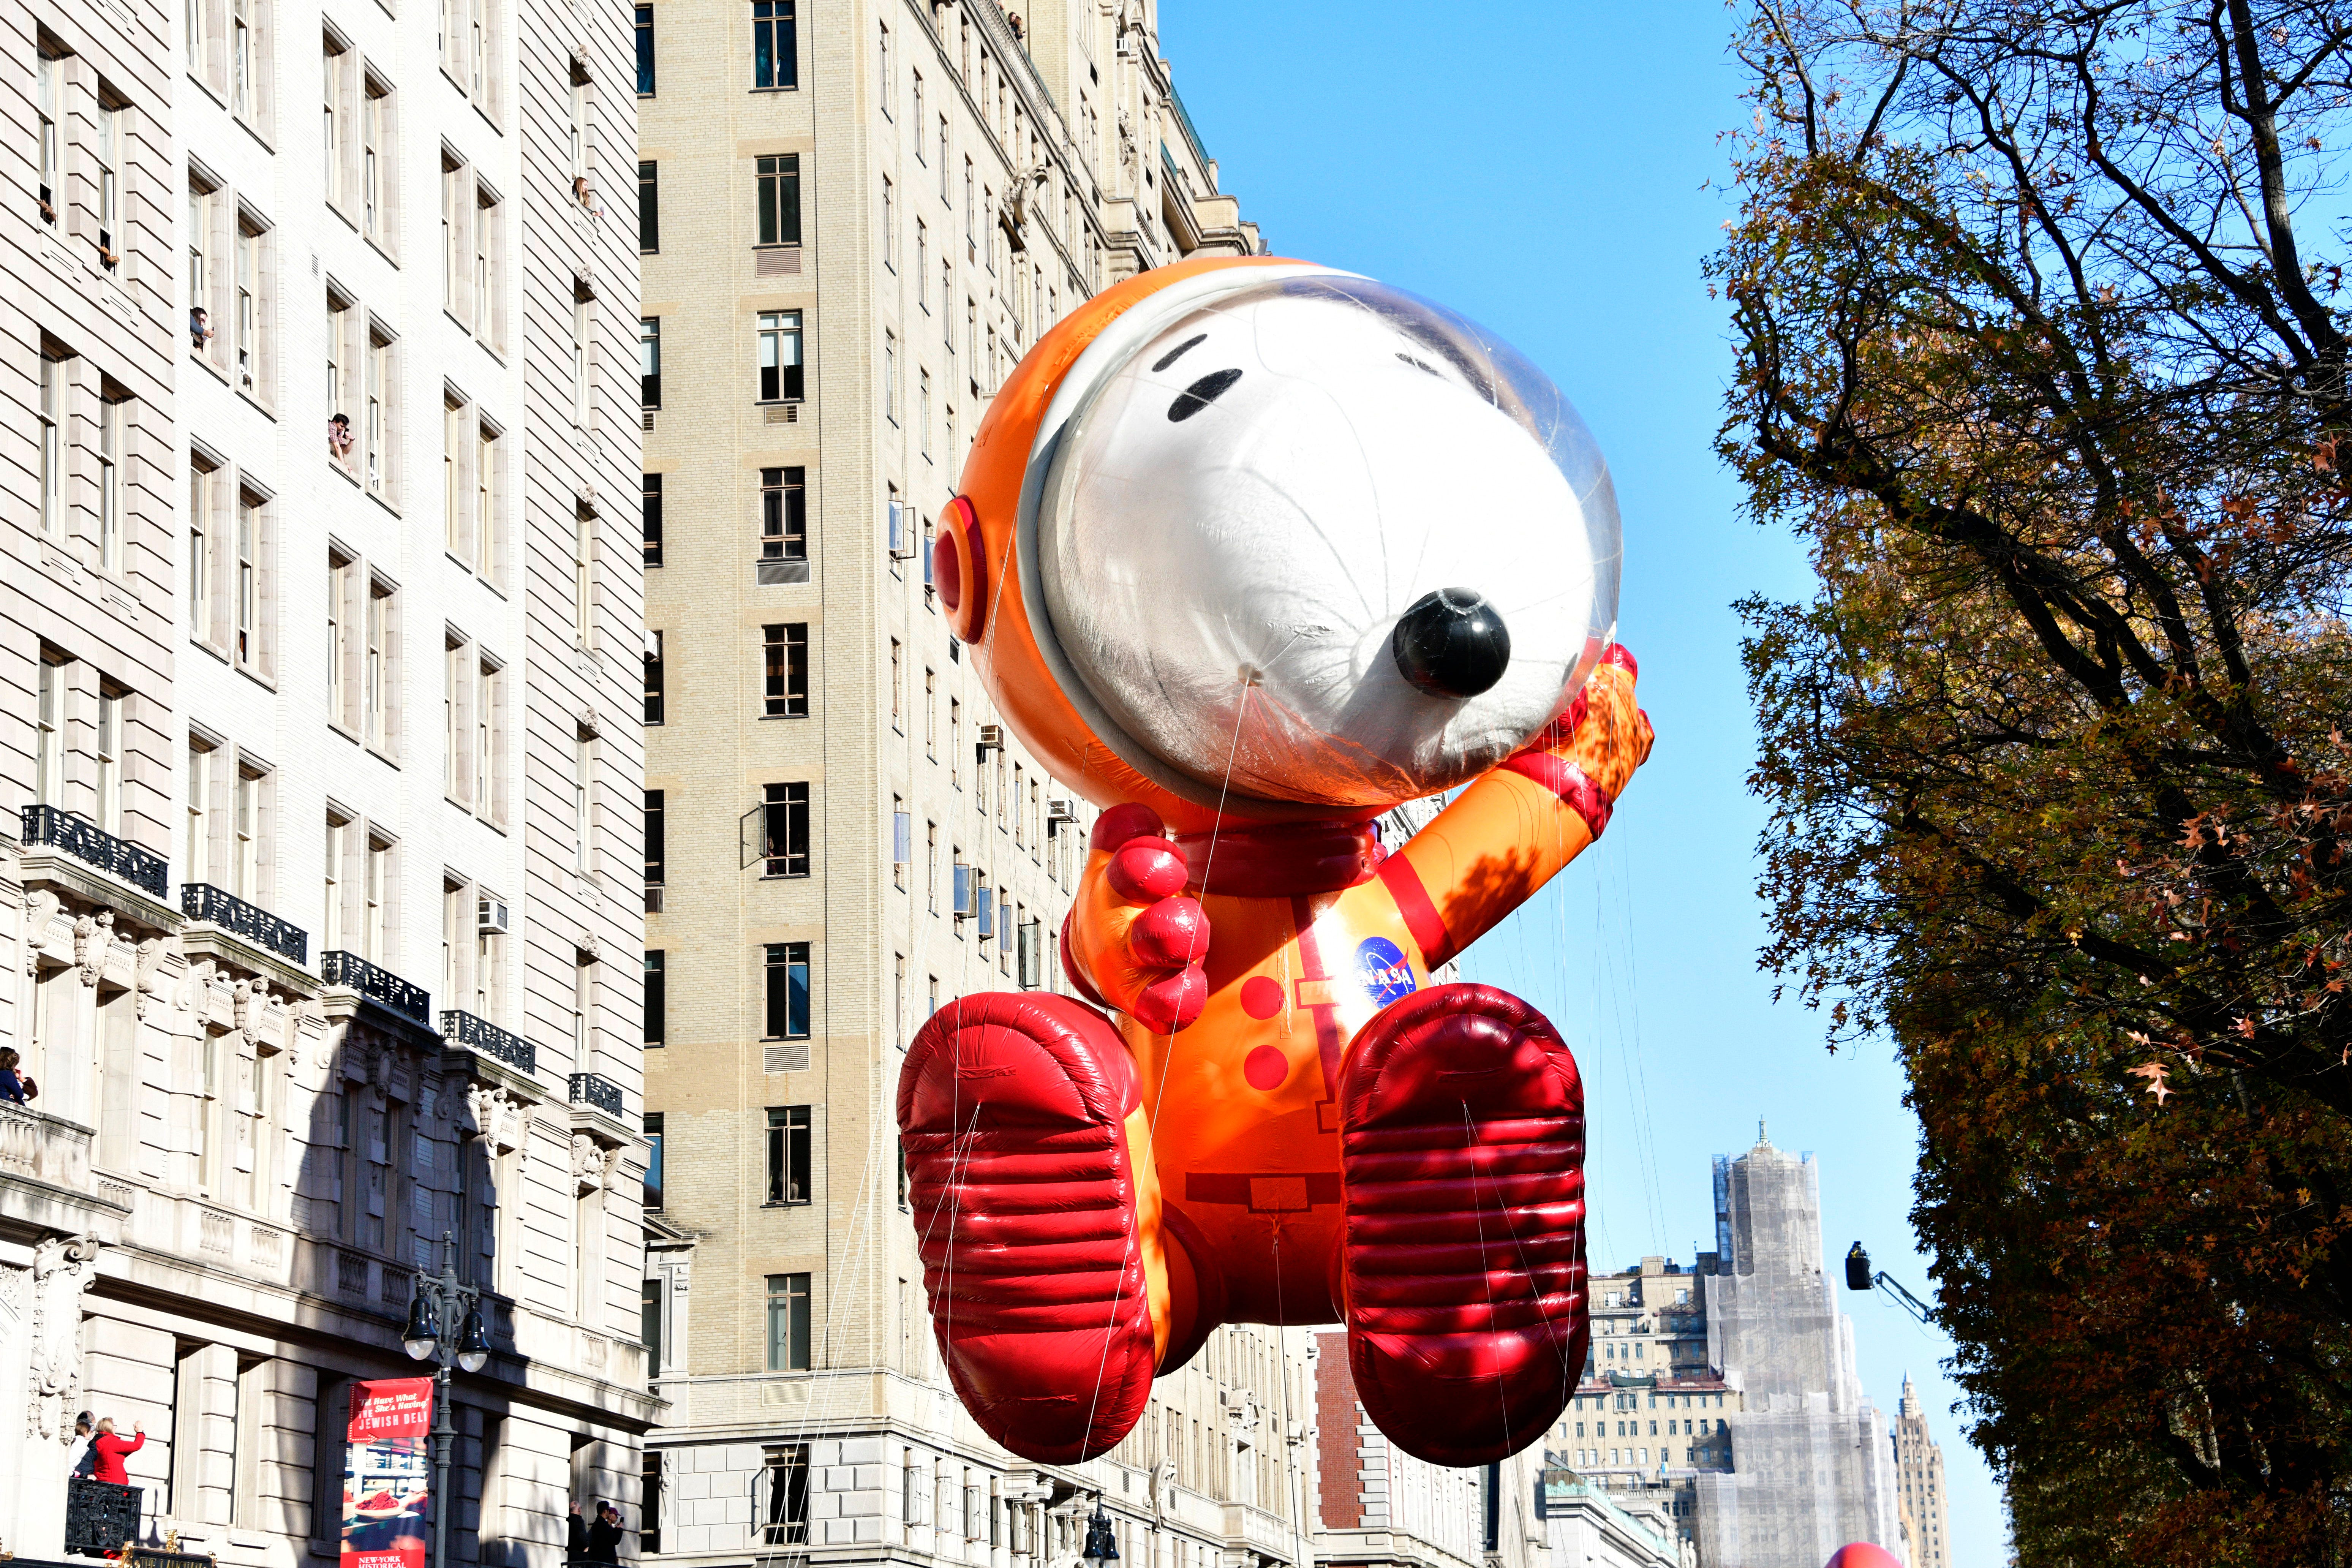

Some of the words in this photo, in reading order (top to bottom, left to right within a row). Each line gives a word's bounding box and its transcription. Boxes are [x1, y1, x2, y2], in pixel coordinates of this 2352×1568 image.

[1361, 968, 1413, 985] NASA
[395, 1393, 417, 1402] What
[375, 1404, 396, 1413] She's
[398, 1398, 430, 1410] Having"
[358, 1409, 373, 1419] THE
[359, 1415, 398, 1430] JEWISH
[404, 1411, 427, 1424] DELI
[359, 1555, 401, 1564] NEW-YORK
